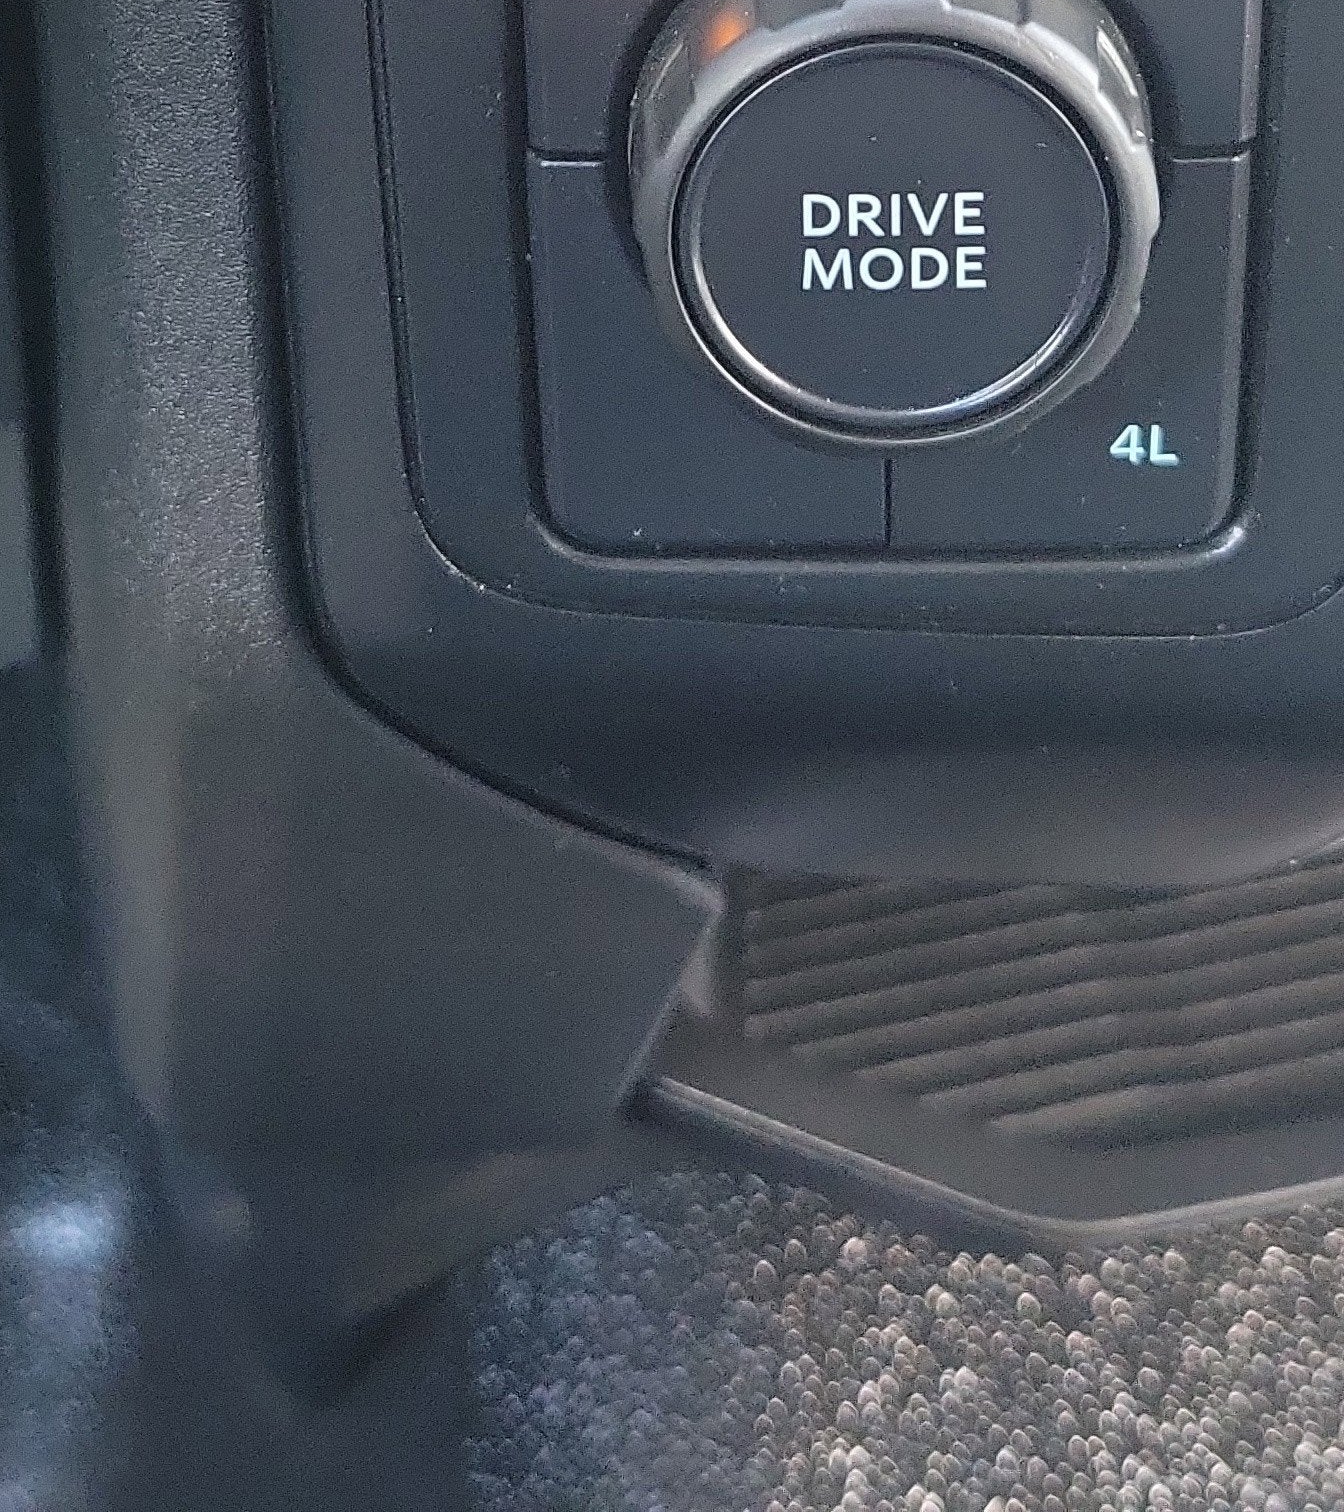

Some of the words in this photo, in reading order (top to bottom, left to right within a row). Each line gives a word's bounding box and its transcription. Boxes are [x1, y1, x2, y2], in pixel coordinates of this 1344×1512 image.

[801, 190, 986, 238] DRIVE
[801, 245, 988, 292] MODE
[1108, 423, 1180, 467] 4L
